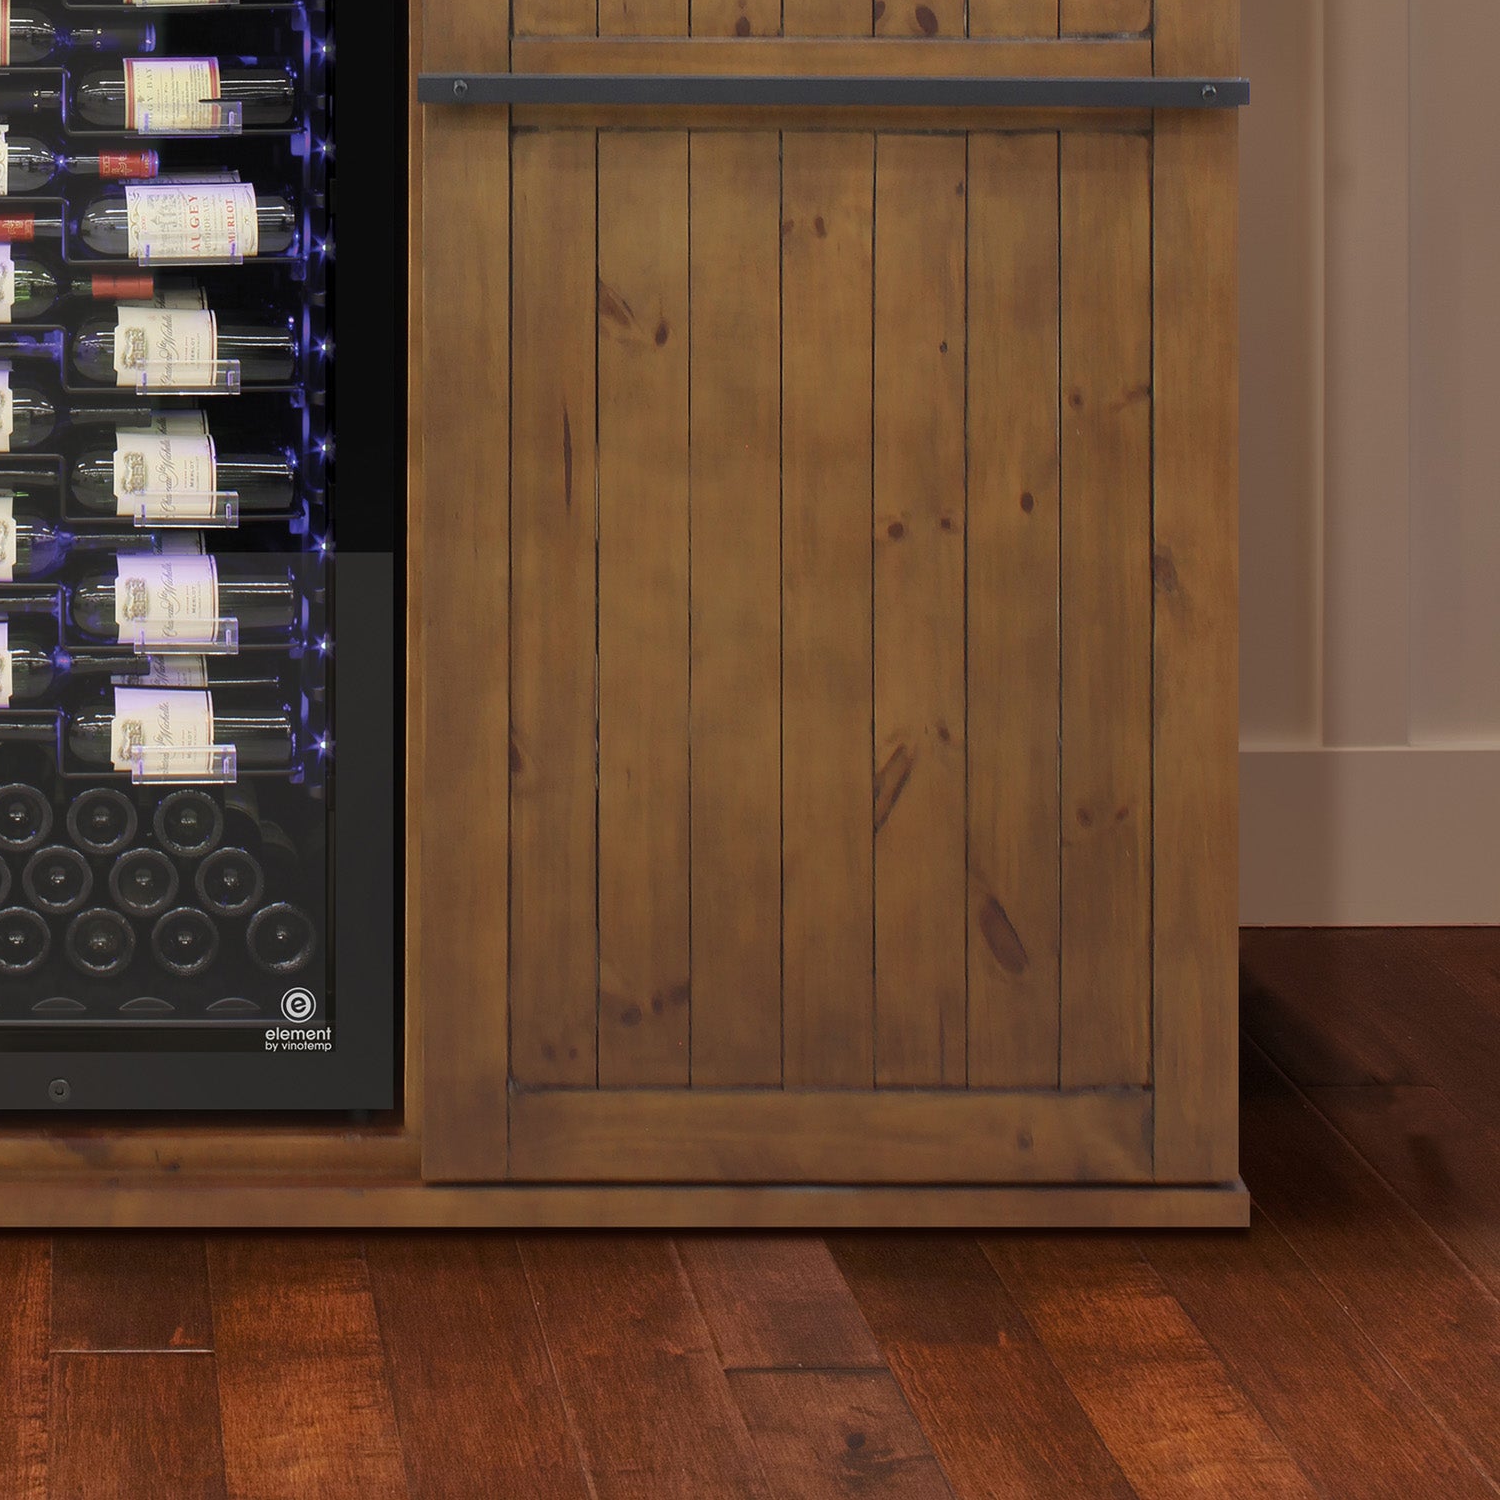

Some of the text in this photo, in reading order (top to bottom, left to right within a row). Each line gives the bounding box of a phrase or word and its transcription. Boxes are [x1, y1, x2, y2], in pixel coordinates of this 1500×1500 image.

[188, 194, 201, 252] AUGEY
[225, 198, 236, 243] MERLOT
[160, 314, 178, 353] Michelle
[161, 562, 179, 603] Michelle
[156, 701, 173, 744] Michelle
[265, 1027, 332, 1040] element
[265, 1041, 332, 1052] by vinotemp
